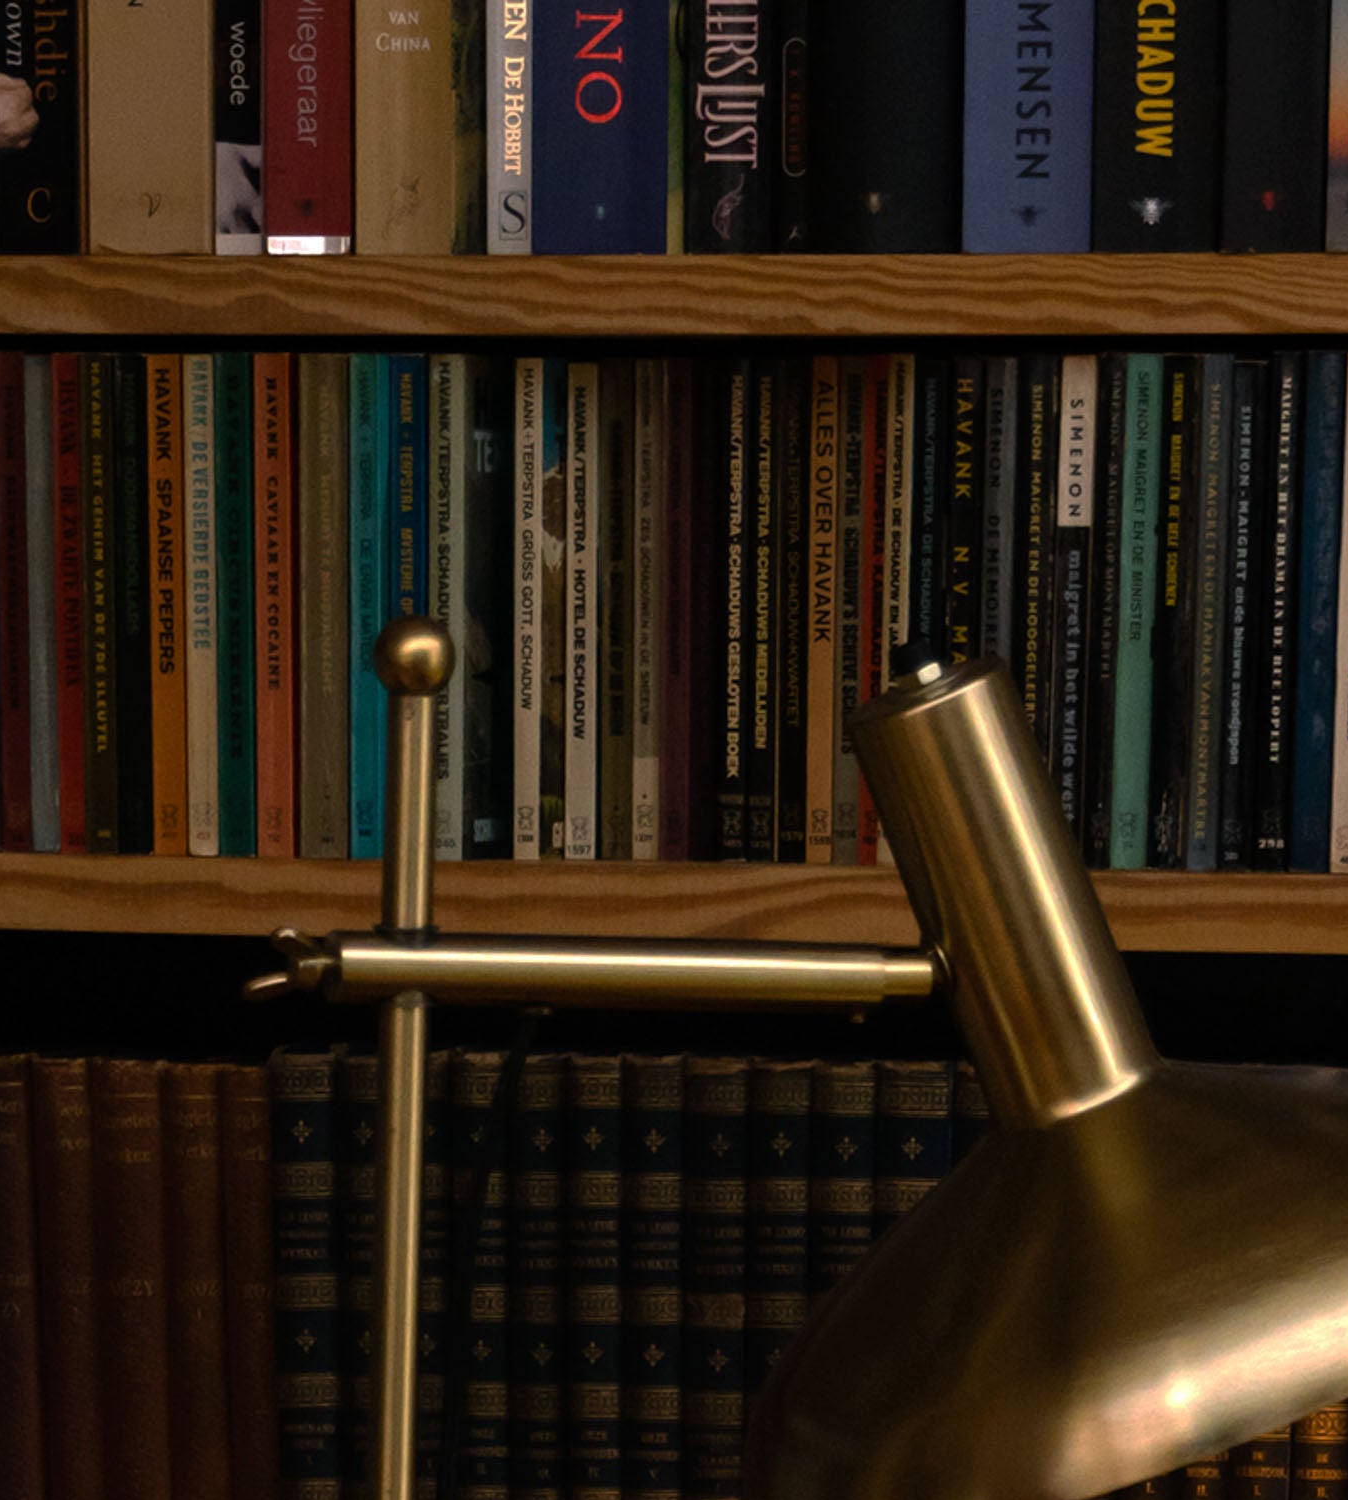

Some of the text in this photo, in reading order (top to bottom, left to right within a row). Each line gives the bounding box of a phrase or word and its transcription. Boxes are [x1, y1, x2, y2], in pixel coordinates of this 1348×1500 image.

[228, 21, 245, 106] woede
[389, 10, 419, 27] VAN
[1135, 0, 1175, 158] CHADUW
[156, 369, 175, 674] HAVANK SPAANSE PEPERS
[815, 381, 833, 643] ALLES OVER HAVANK
[1130, 372, 1149, 641] SIMENON MAIGRET EN DE MINISTER
